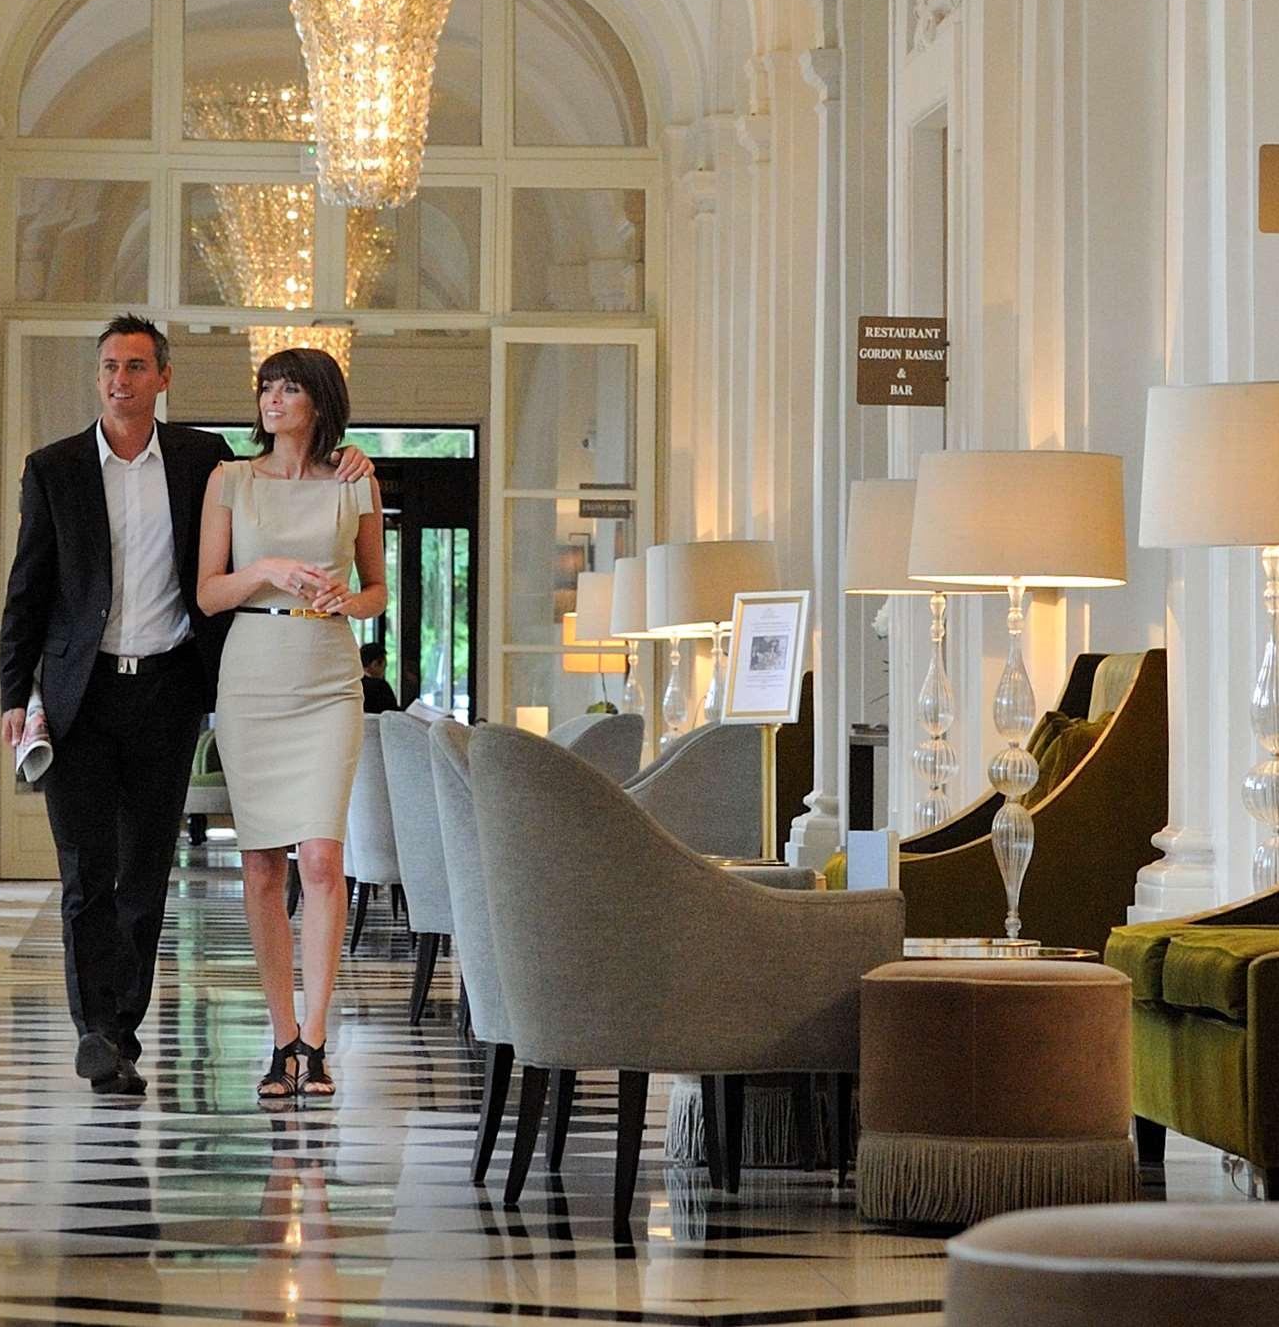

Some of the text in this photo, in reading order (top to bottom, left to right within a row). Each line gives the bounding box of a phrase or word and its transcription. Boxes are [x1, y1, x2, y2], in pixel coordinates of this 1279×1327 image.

[864, 326, 941, 339] RESTAURANT
[859, 347, 945, 361] GORDON RAMSAY
[896, 367, 907, 379] &
[890, 384, 913, 396] BAR
